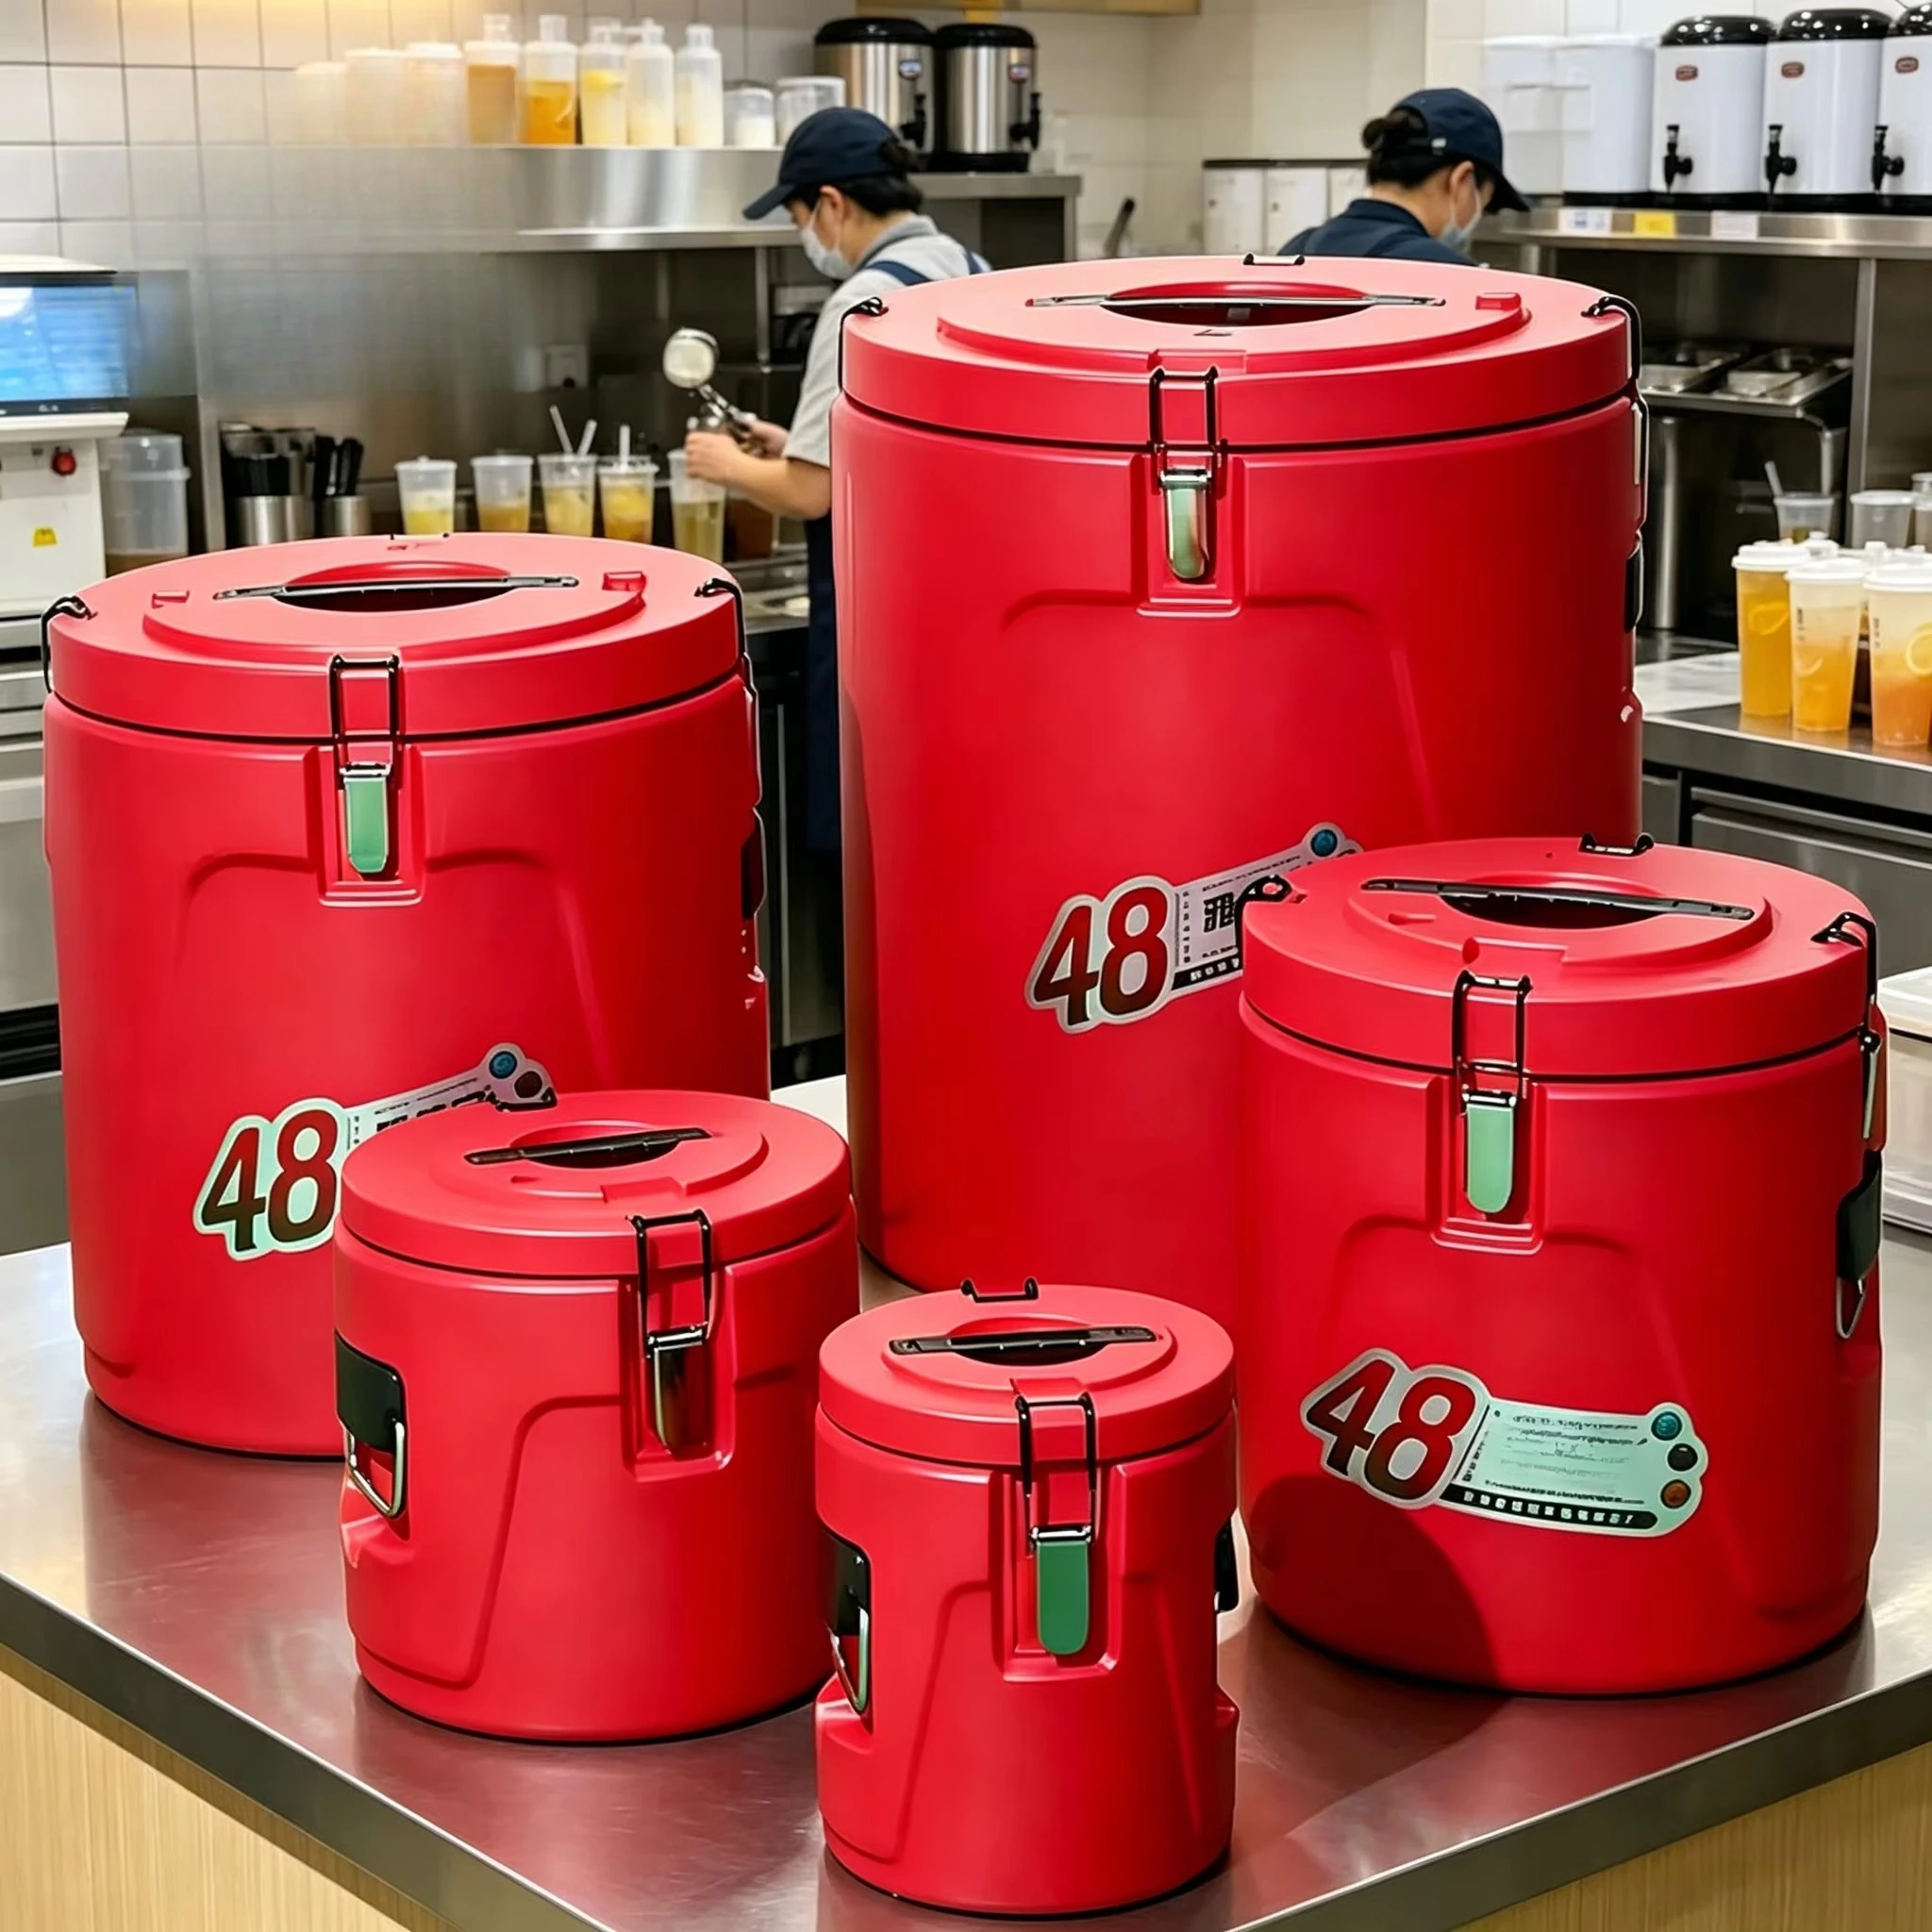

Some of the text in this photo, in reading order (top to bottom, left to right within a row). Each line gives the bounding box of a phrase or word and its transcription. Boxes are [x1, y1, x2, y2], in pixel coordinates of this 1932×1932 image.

[1034, 887, 1168, 1026] 48
[202, 1109, 338, 1252] 48
[1306, 1359, 1475, 1500] 48
